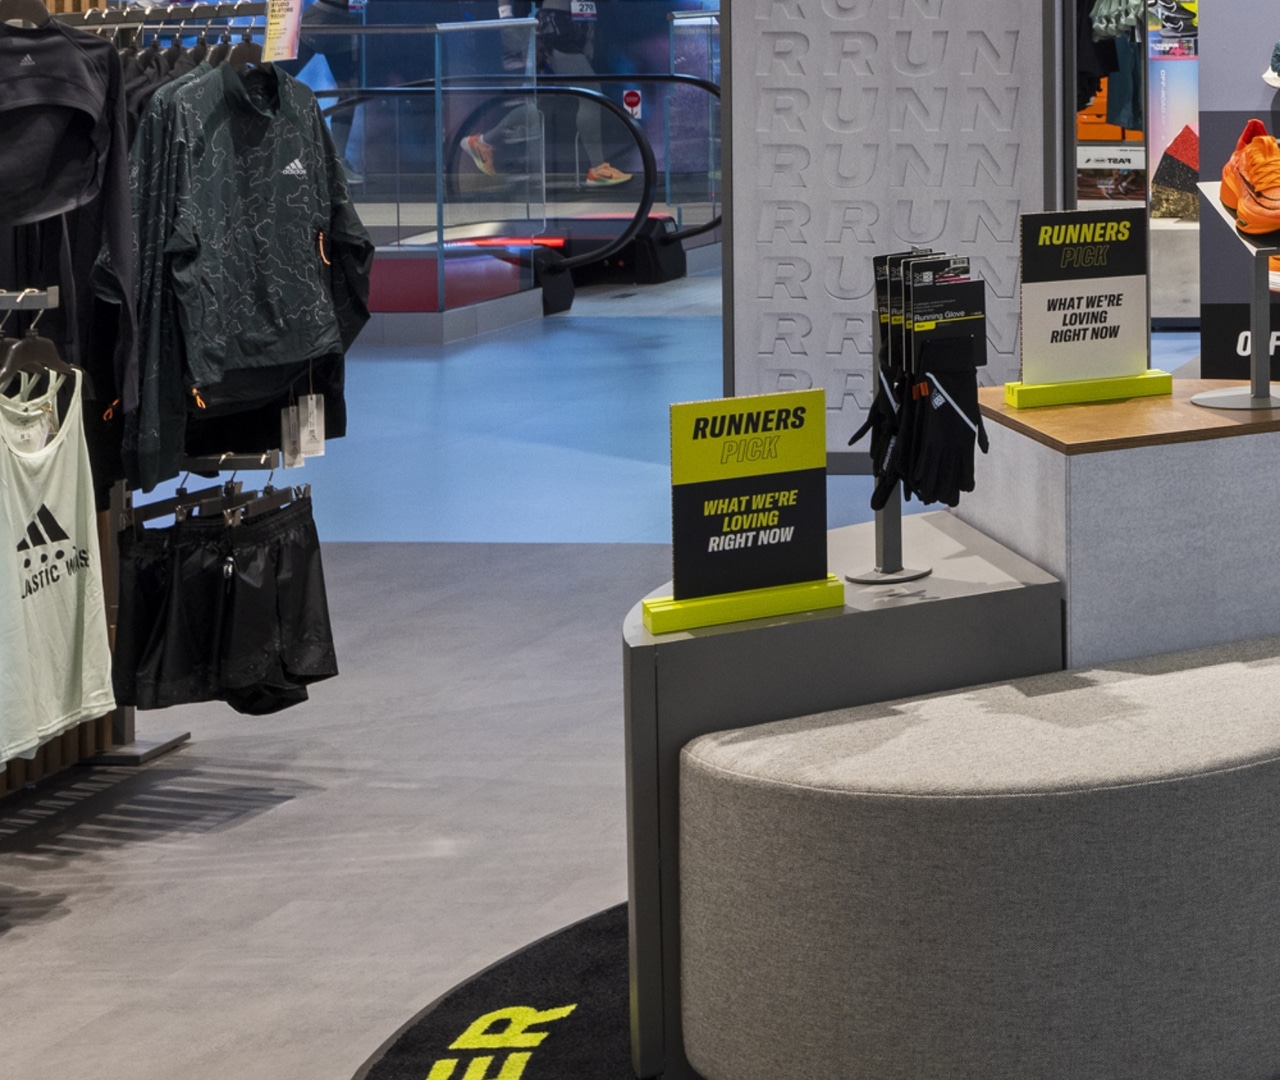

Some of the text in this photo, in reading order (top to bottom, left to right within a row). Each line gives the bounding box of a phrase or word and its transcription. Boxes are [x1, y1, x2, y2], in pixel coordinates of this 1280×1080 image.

[1038, 220, 1131, 247] RUNNERS
[1061, 245, 1110, 268] PICK
[1046, 293, 1123, 312] WHAT WE'RE
[914, 310, 965, 322] Running Glove
[1062, 310, 1108, 328] LOVING
[1050, 325, 1120, 345] RIGHT NOW
[693, 406, 807, 440] RUNNERS
[720, 435, 780, 464] PICK
[703, 489, 799, 516] WHAT WE'RE
[722, 510, 780, 532] LOVING
[708, 526, 795, 552] RIGHT NOW
